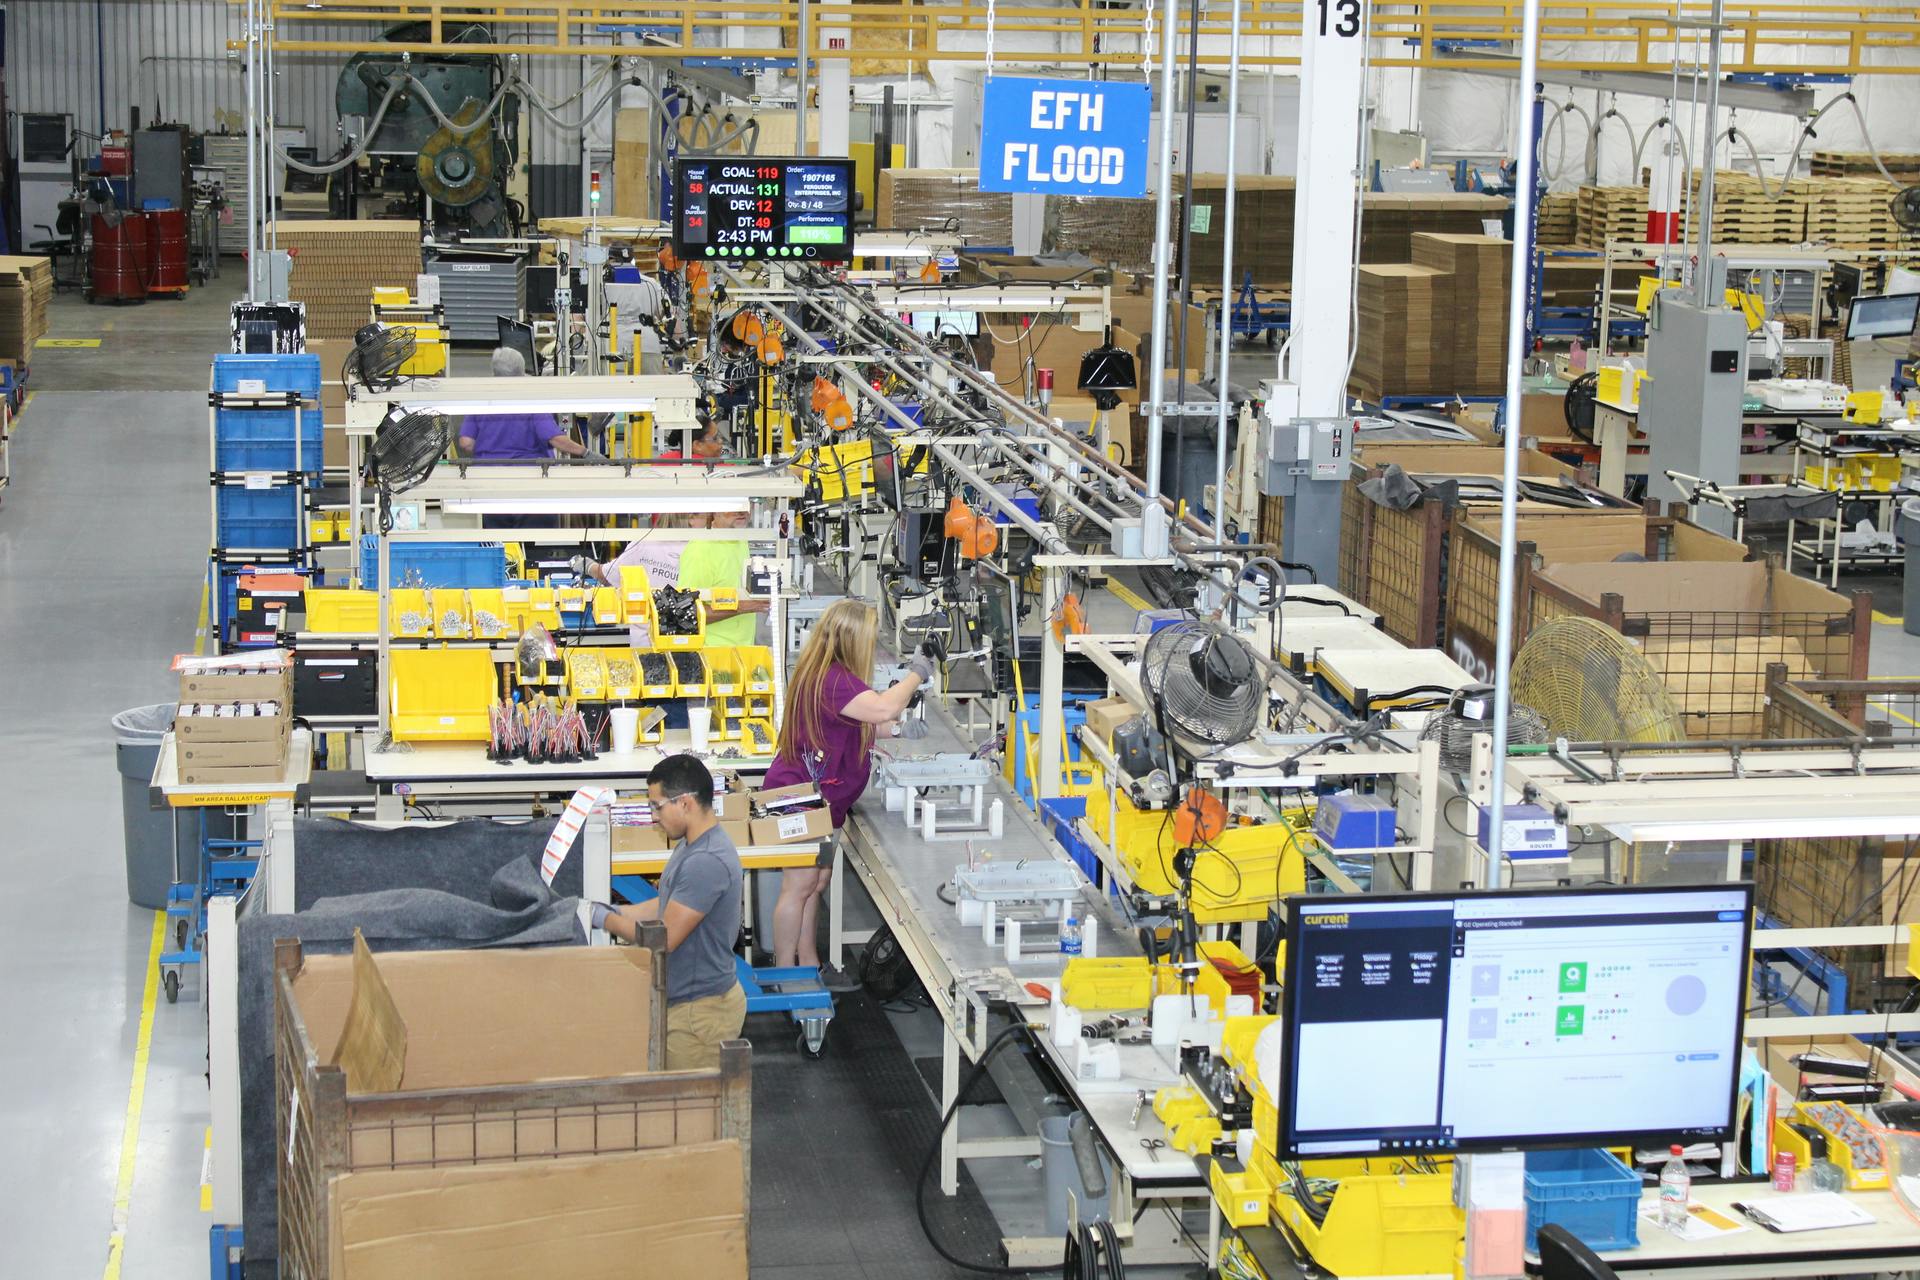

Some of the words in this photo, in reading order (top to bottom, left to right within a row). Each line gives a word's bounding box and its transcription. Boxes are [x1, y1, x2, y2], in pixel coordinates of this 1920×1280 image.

[1317, 0, 1360, 37] 13
[1030, 91, 1104, 132] EFH
[1003, 142, 1125, 185] FLOOD
[722, 166, 755, 178] GOAL:
[756, 167, 778, 179] 119
[802, 174, 836, 182] 1907165
[689, 183, 703, 193] 58
[709, 183, 754, 195] ACTUAL:
[756, 184, 779, 196] 131
[730, 200, 755, 211] DEV:
[756, 200, 772, 212] 12
[787, 201, 800, 209] Qty:
[801, 201, 807, 209] 8
[812, 201, 823, 209] 48
[688, 217, 703, 227] 34
[737, 216, 755, 227] DT:
[755, 217, 771, 228] 49
[717, 230, 747, 243] 2:43
[750, 230, 773, 243] PM
[1304, 913, 1349, 925] current
